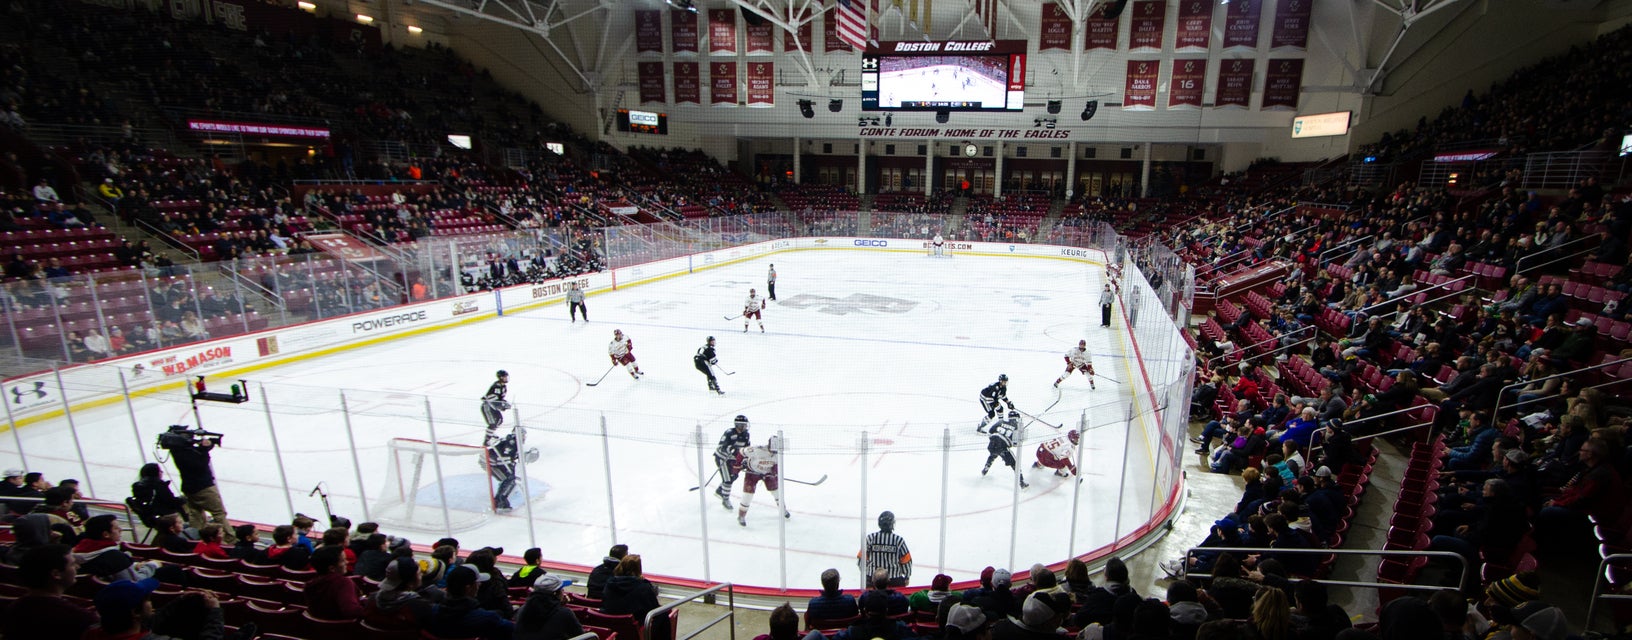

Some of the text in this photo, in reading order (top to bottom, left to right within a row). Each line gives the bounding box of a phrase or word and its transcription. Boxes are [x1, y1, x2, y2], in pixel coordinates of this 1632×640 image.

[895, 41, 991, 51] BOSTON COLLEGE
[1180, 80, 1194, 89] 16
[631, 114, 656, 122] GEICO
[860, 128, 1071, 139] CONTE FORUM HOME OF THE EAGLES
[854, 239, 887, 247] GEICO
[923, 242, 972, 250] BCLES.COM
[1061, 248, 1087, 257] KEURIG
[532, 278, 589, 298] BOSTON COEGE
[353, 310, 427, 333] POWERADE
